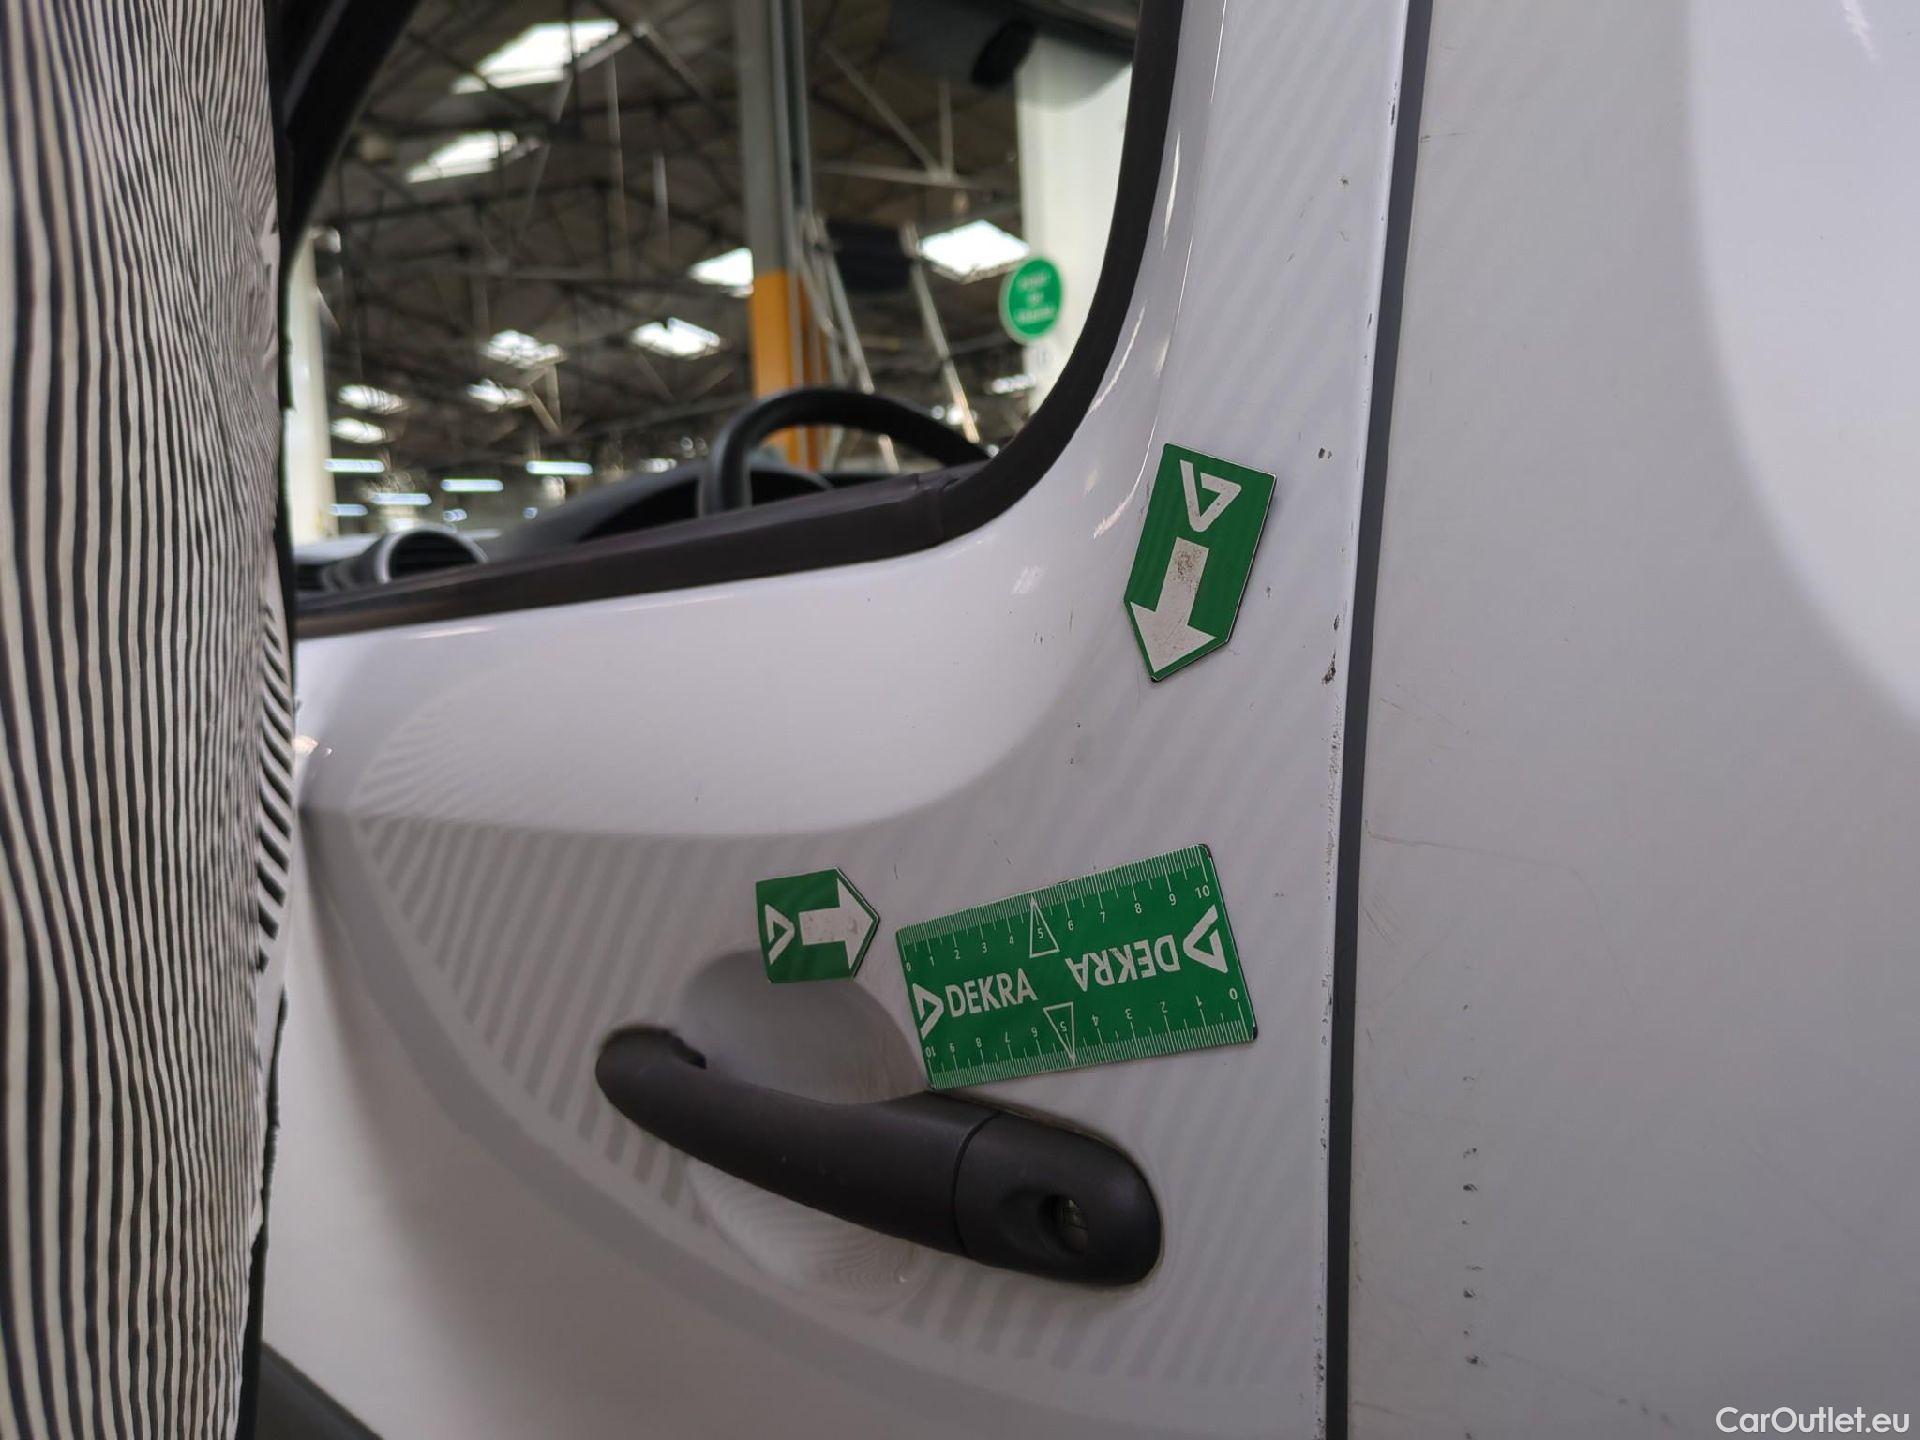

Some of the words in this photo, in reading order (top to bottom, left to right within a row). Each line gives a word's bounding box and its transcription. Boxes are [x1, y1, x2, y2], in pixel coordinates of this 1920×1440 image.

[906, 961, 912, 973] 0
[929, 956, 935, 967] 1
[954, 950, 961, 960] 2
[982, 942, 988, 954] 3
[1009, 935, 1014, 945] 4
[1037, 928, 1044, 939] 5
[1068, 920, 1074, 931] 6
[1100, 911, 1106, 923] 7
[1134, 903, 1142, 914] 8
[1168, 893, 1177, 906] 9
[1195, 885, 1210, 899] 10
[1065, 934, 1181, 992] DEKRA
[945, 968, 1038, 1018] DEKRA
[1229, 988, 1238, 1000] 0
[1160, 1001, 1168, 1013] 2
[1196, 995, 1202, 1007] 1
[1091, 1014, 1099, 1026] 4
[1125, 1008, 1132, 1020] 3
[1031, 1027, 1038, 1038] 6
[1060, 1021, 1067, 1032] 5
[976, 1037, 982, 1048] 8
[1005, 1032, 1011, 1043] 7
[925, 1047, 936, 1058] 10
[949, 1043, 956, 1053] 9
